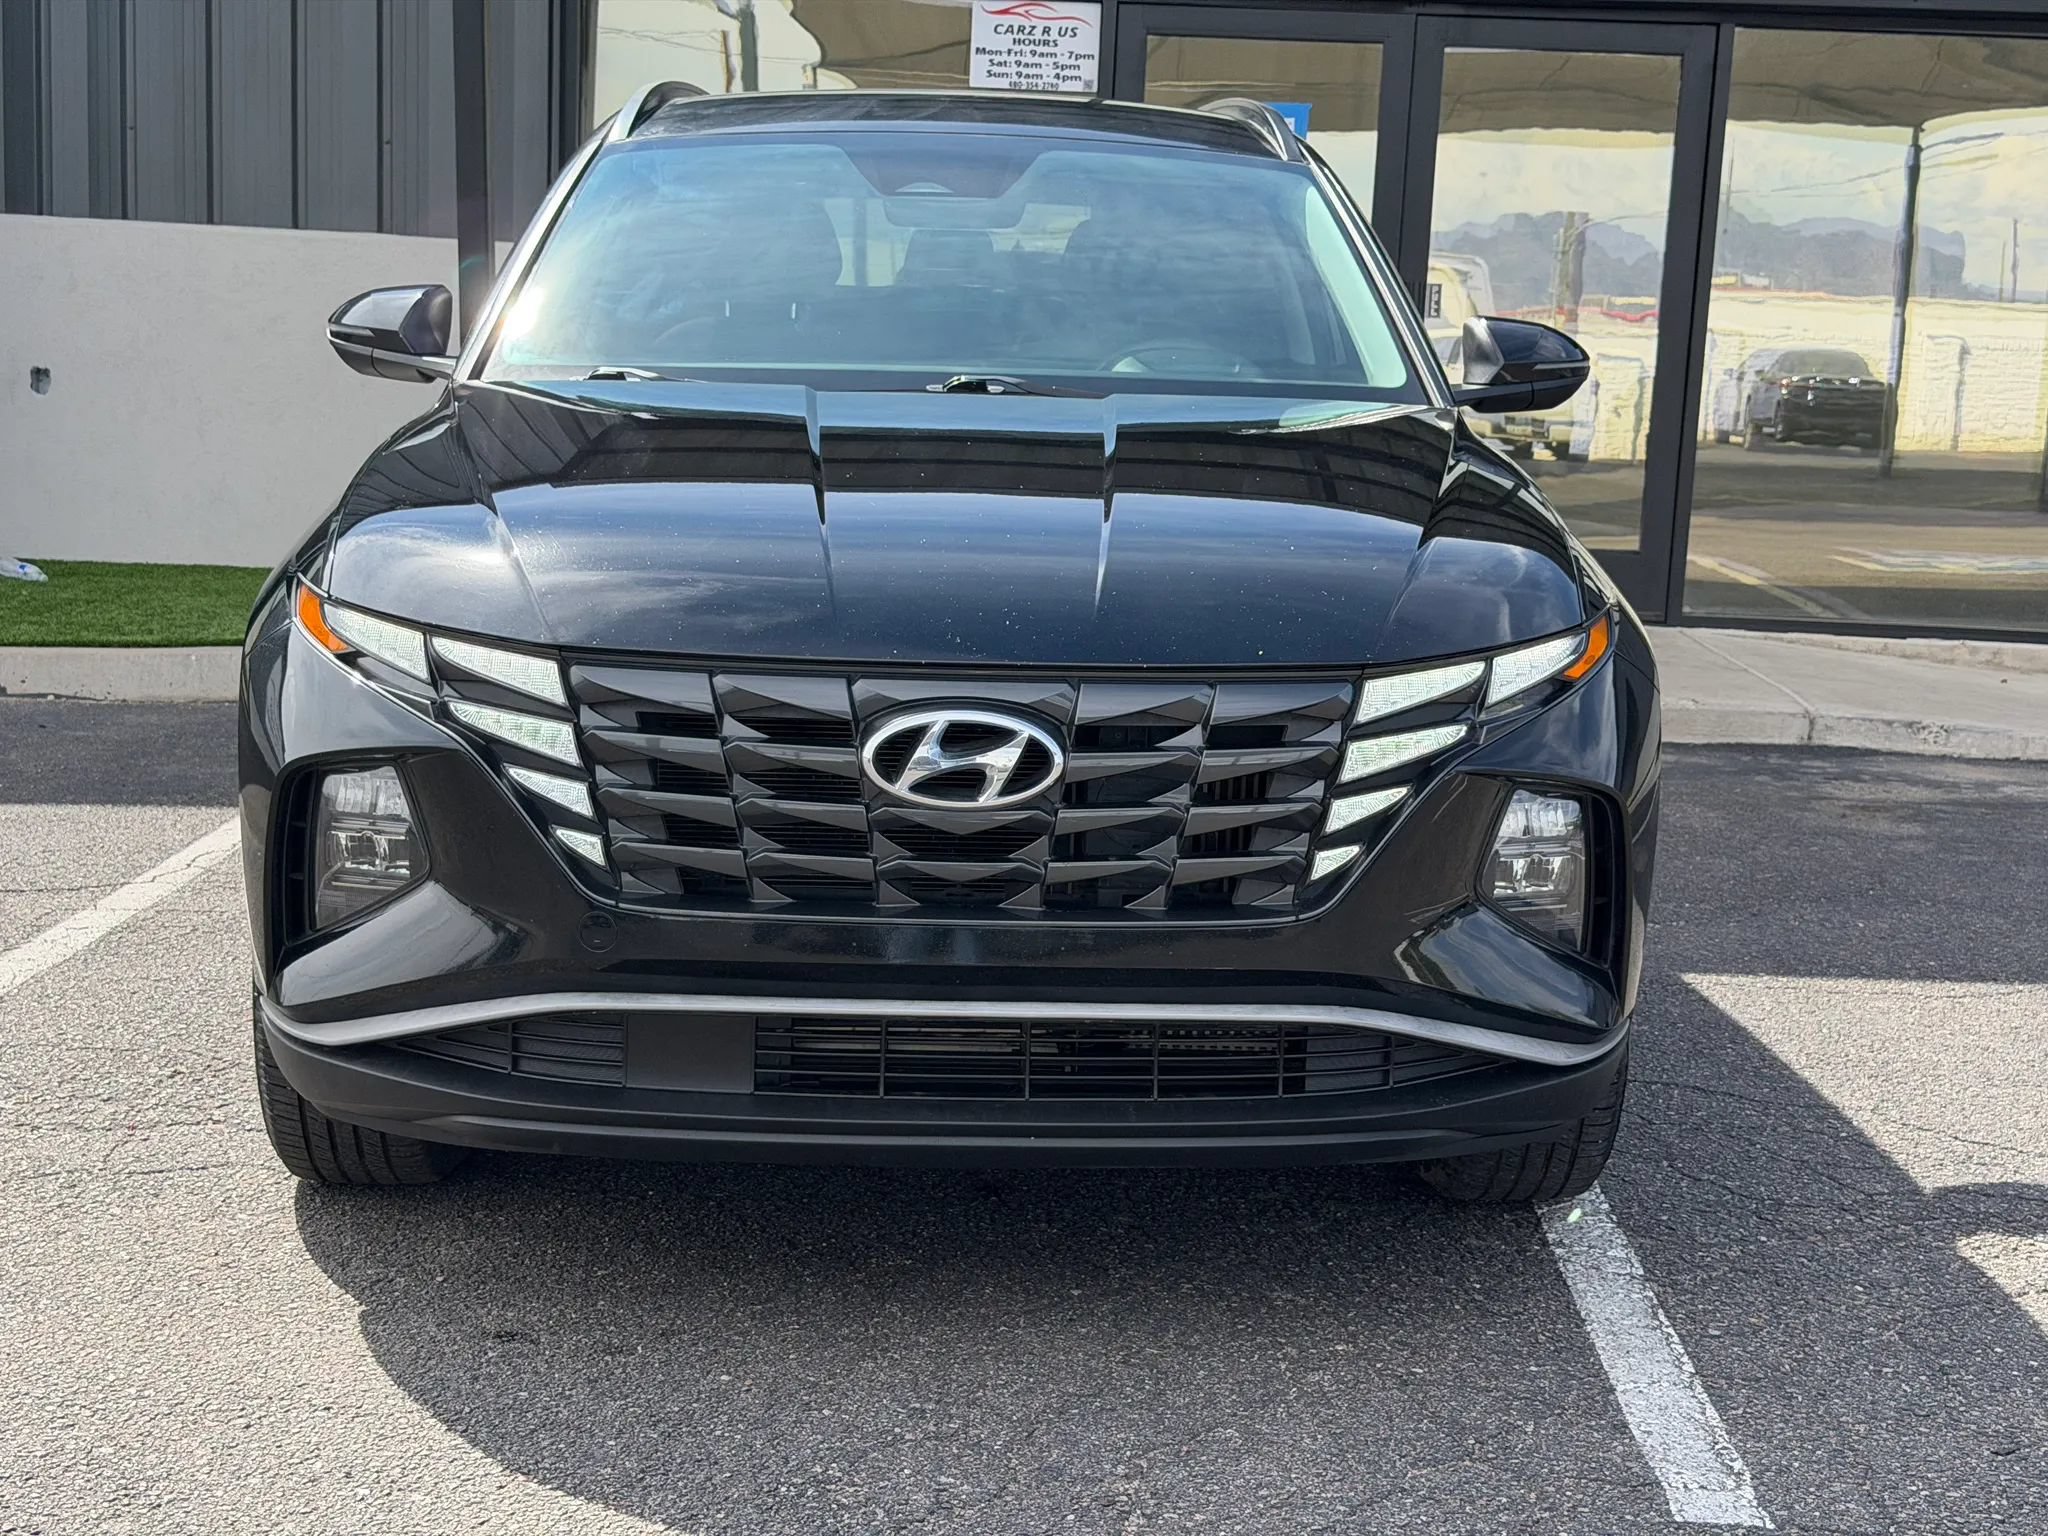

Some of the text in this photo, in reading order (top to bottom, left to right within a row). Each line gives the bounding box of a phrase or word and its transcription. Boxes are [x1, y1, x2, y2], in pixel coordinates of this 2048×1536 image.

[993, 24, 1079, 38] CARZ R US
[1012, 37, 1059, 47] HOURS
[975, 47, 1028, 57] Mon-Fri:
[1029, 49, 1058, 59] 9am
[1067, 51, 1095, 61] 7pm
[988, 59, 1012, 68] Sat:
[1014, 60, 1042, 69] 9am
[1052, 62, 1081, 72] 5pm
[986, 70, 1013, 79] Sun:
[1015, 71, 1043, 80] 9am
[1053, 72, 1082, 83] 4pm
